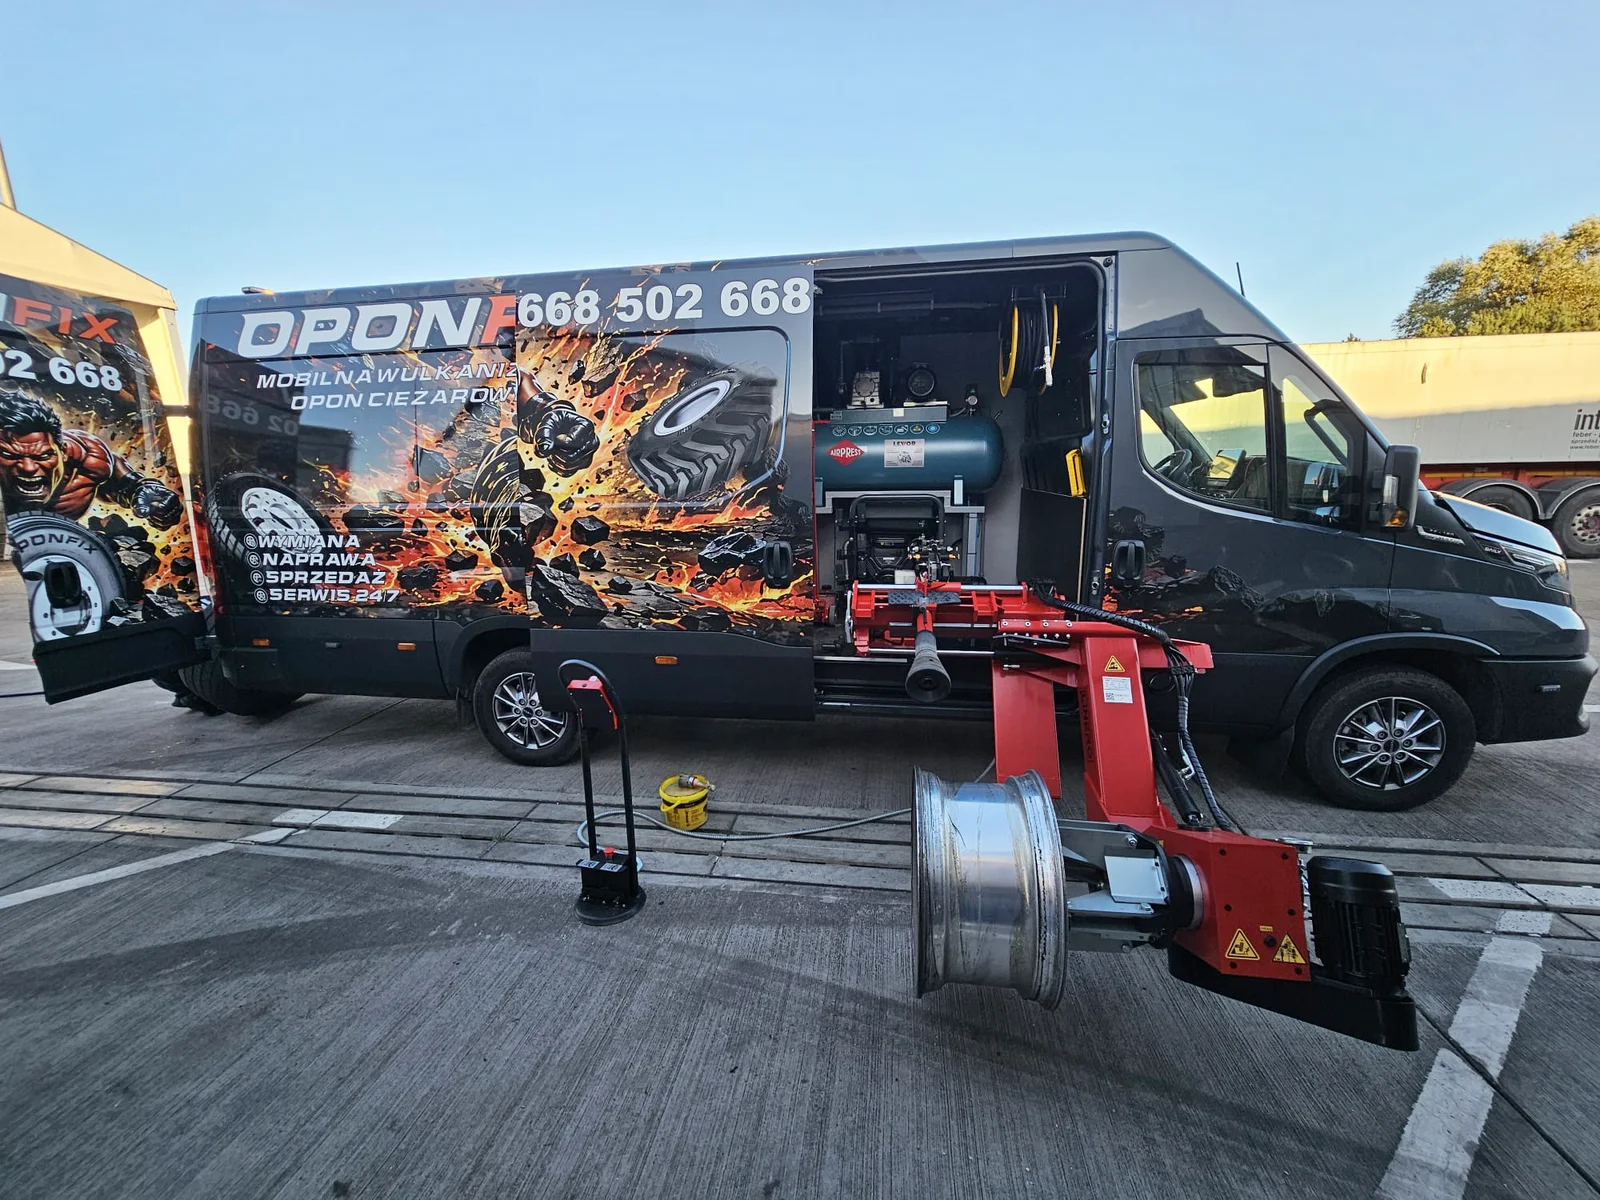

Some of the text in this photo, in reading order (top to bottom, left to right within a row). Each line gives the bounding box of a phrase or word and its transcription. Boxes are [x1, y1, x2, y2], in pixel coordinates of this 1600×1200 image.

[516, 277, 812, 328] 668 502 668
[0, 292, 119, 345] FIX
[0, 349, 123, 392] 2 668
[256, 369, 372, 389] MOBILNA
[290, 393, 363, 410] OPON
[830, 447, 861, 458] AIRPRESS
[258, 534, 361, 548] WYMIANA
[262, 553, 377, 566] NAPRAWA
[269, 588, 350, 602] SERWIS
